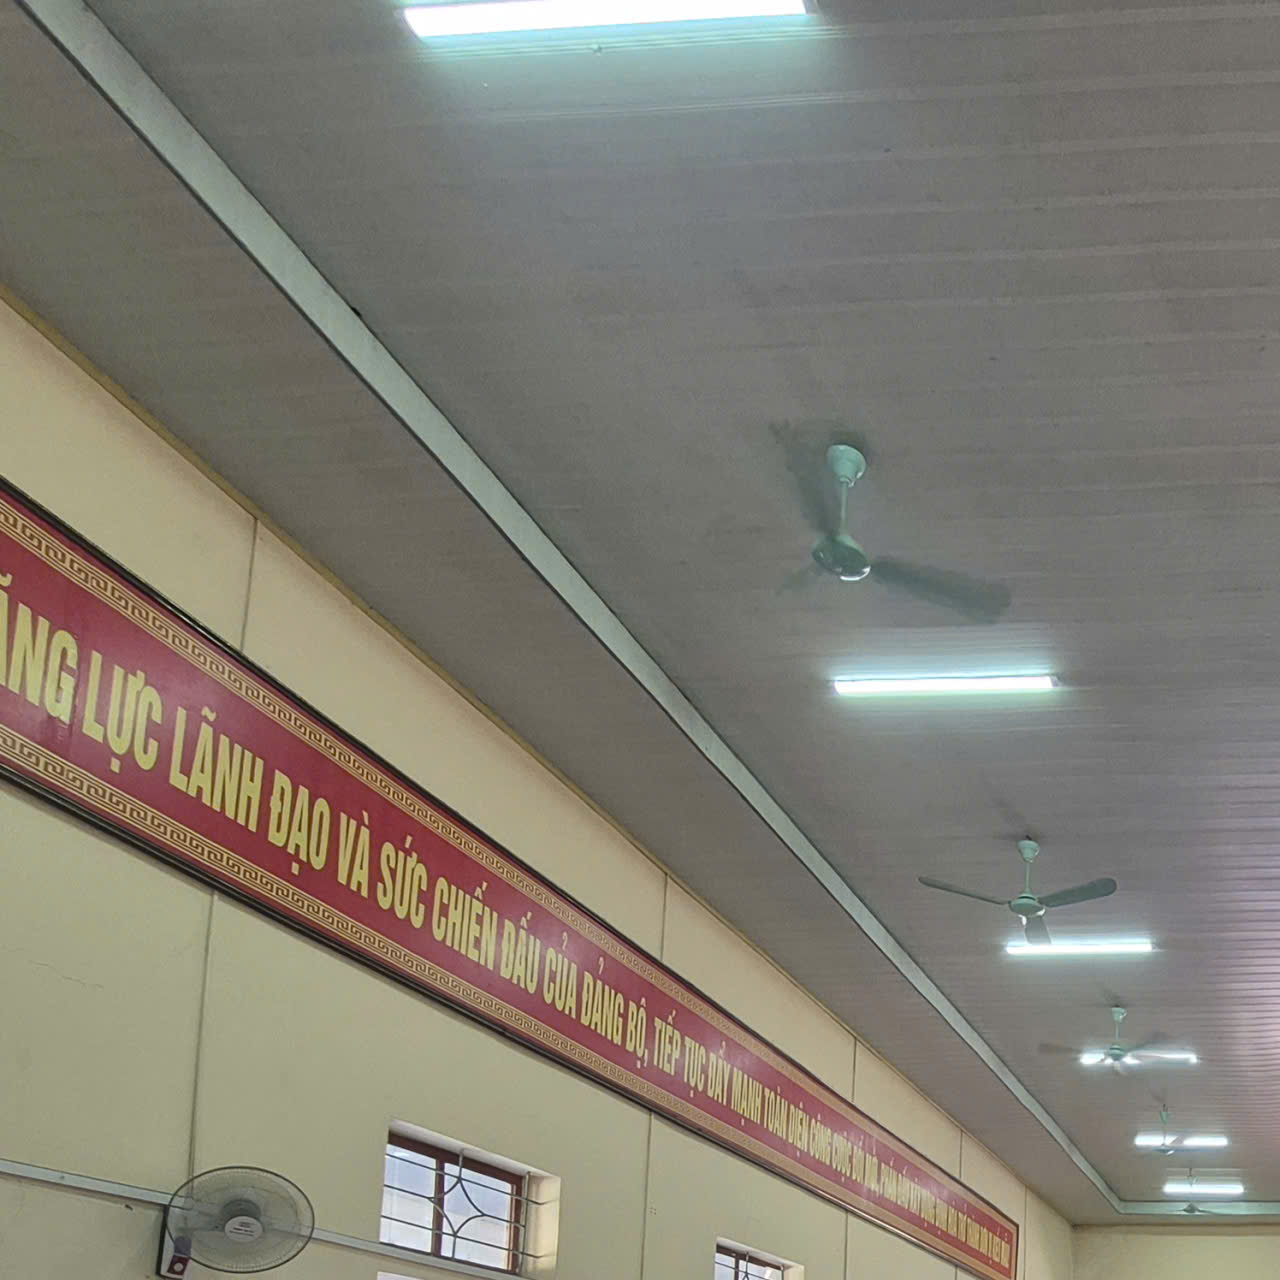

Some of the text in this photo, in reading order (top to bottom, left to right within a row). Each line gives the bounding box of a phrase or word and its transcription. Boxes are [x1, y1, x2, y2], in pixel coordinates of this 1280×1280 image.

[82, 650, 163, 773] LỰC
[169, 706, 264, 832] LÃNH
[268, 769, 331, 875] ĐẠO
[337, 810, 370, 898] VÀ
[377, 835, 428, 929] SỨC
[432, 882, 498, 971] CHIẾN
[500, 912, 541, 994] ĐẤU
[543, 932, 577, 1019] CỦA
[580, 957, 624, 1046] ĐẢNG
[625, 998, 648, 1069] BỘ,
[654, 1009, 681, 1075] TIẾP
[684, 1036, 706, 1097] TỤC
[731, 1066, 762, 1126] MẠNH
